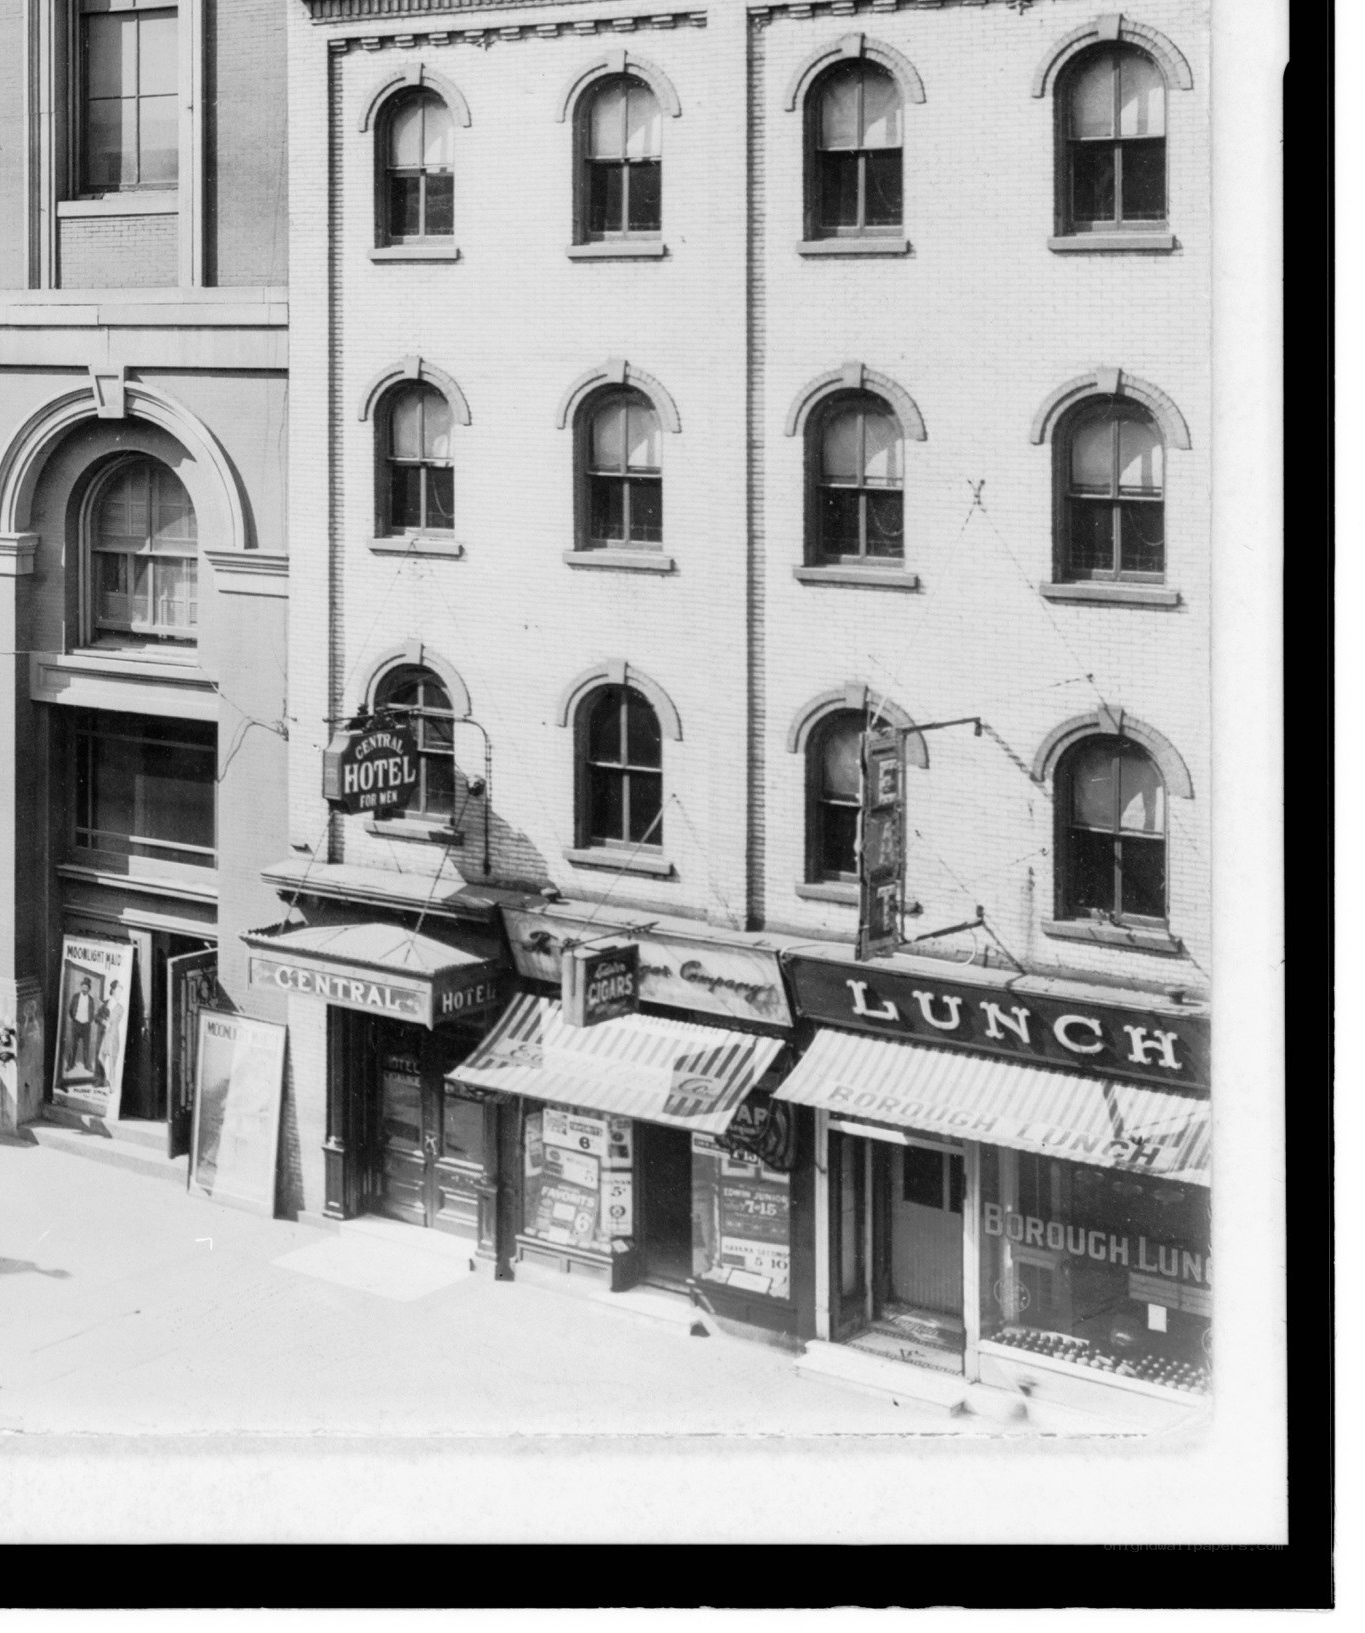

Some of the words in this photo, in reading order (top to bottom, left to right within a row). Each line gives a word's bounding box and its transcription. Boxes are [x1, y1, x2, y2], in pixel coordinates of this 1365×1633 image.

[354, 733, 403, 759] CENTRAL
[344, 755, 416, 794] HOTEL
[359, 793, 377, 808] FOR
[379, 790, 398, 805] MEN
[66, 945, 104, 963] MOONLIGHT
[274, 965, 401, 1011] CENTRAL
[442, 981, 495, 1014] HOTEL
[587, 974, 634, 1006] CIGARS
[845, 979, 1183, 1070] LUNCH
[827, 1084, 998, 1134] BOROUGH
[1014, 1124, 1163, 1168] LUNCH
[983, 1201, 1129, 1266] BOROUGH
